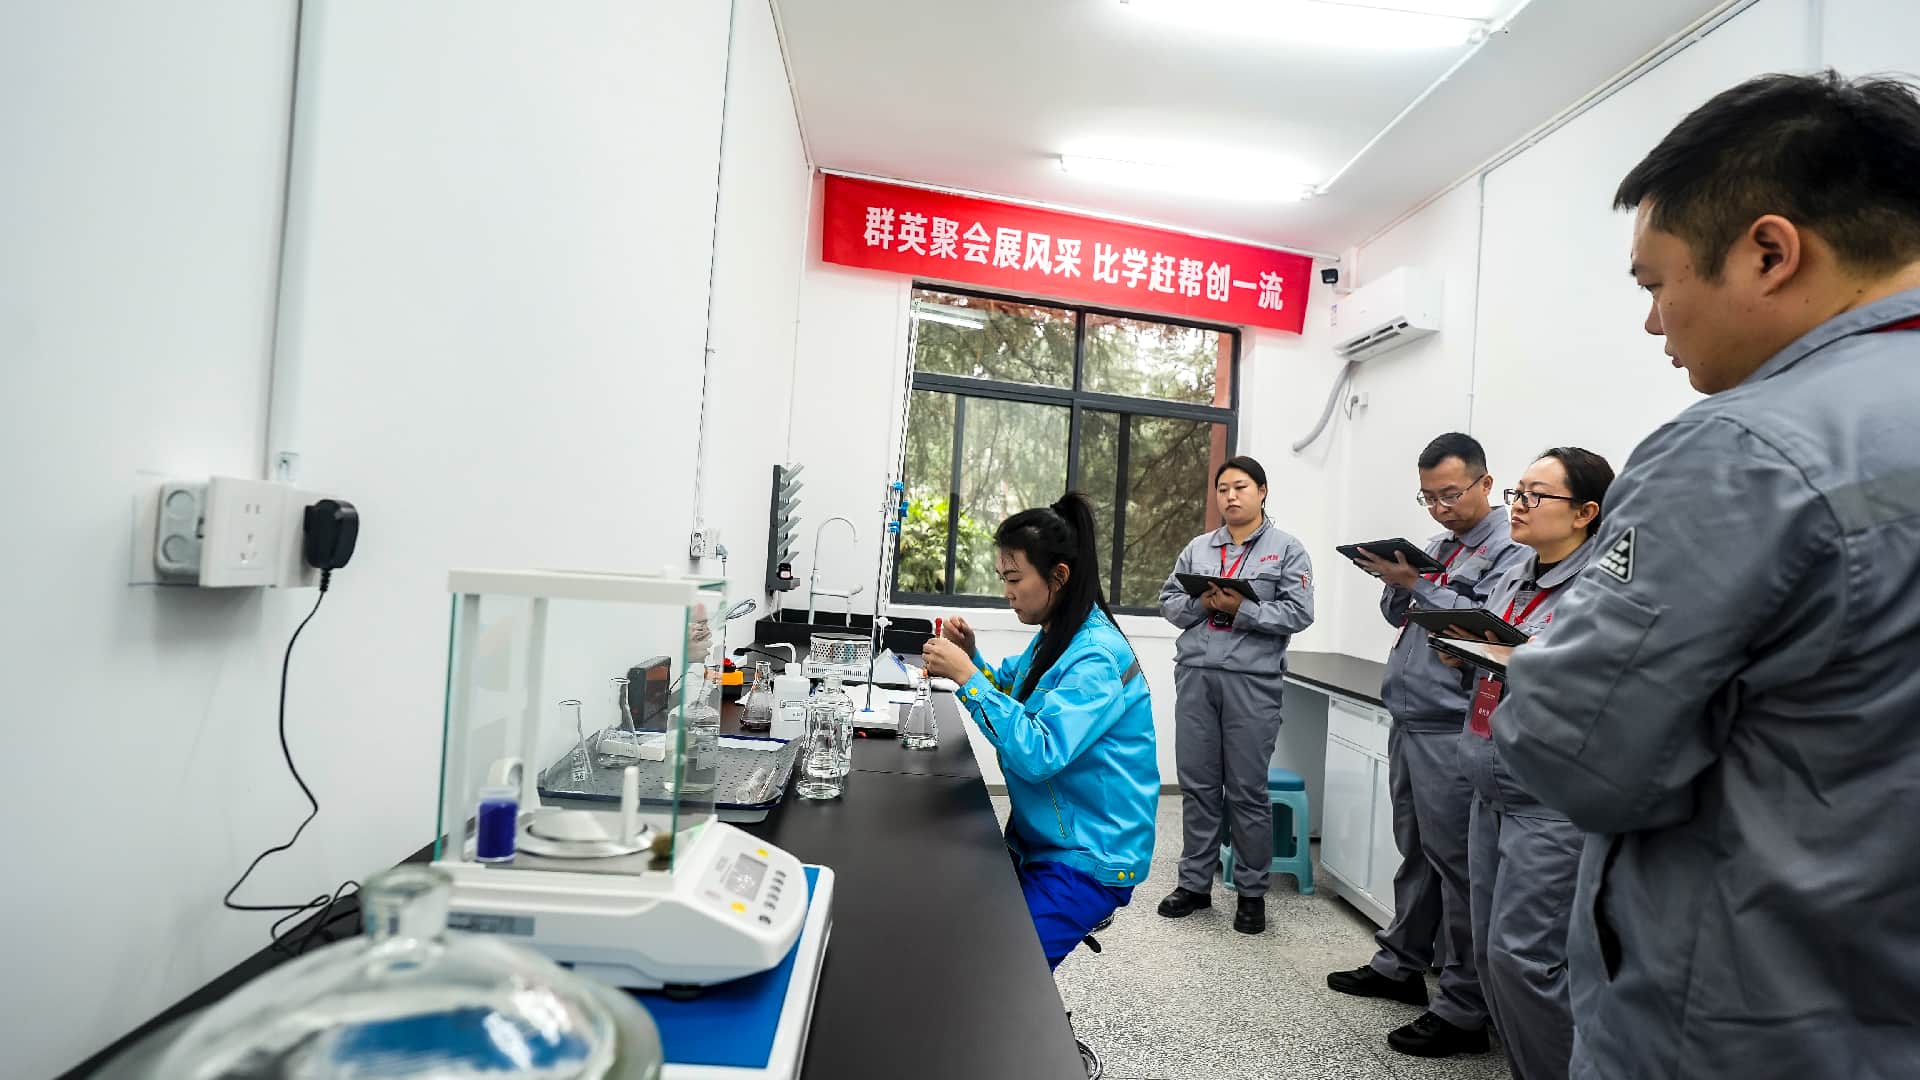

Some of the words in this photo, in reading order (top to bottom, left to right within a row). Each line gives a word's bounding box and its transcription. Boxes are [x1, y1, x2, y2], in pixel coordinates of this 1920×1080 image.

[864, 206, 1082, 278] 群英聚会展风采
[1093, 242, 1284, 311] 比学赶帮创一流
